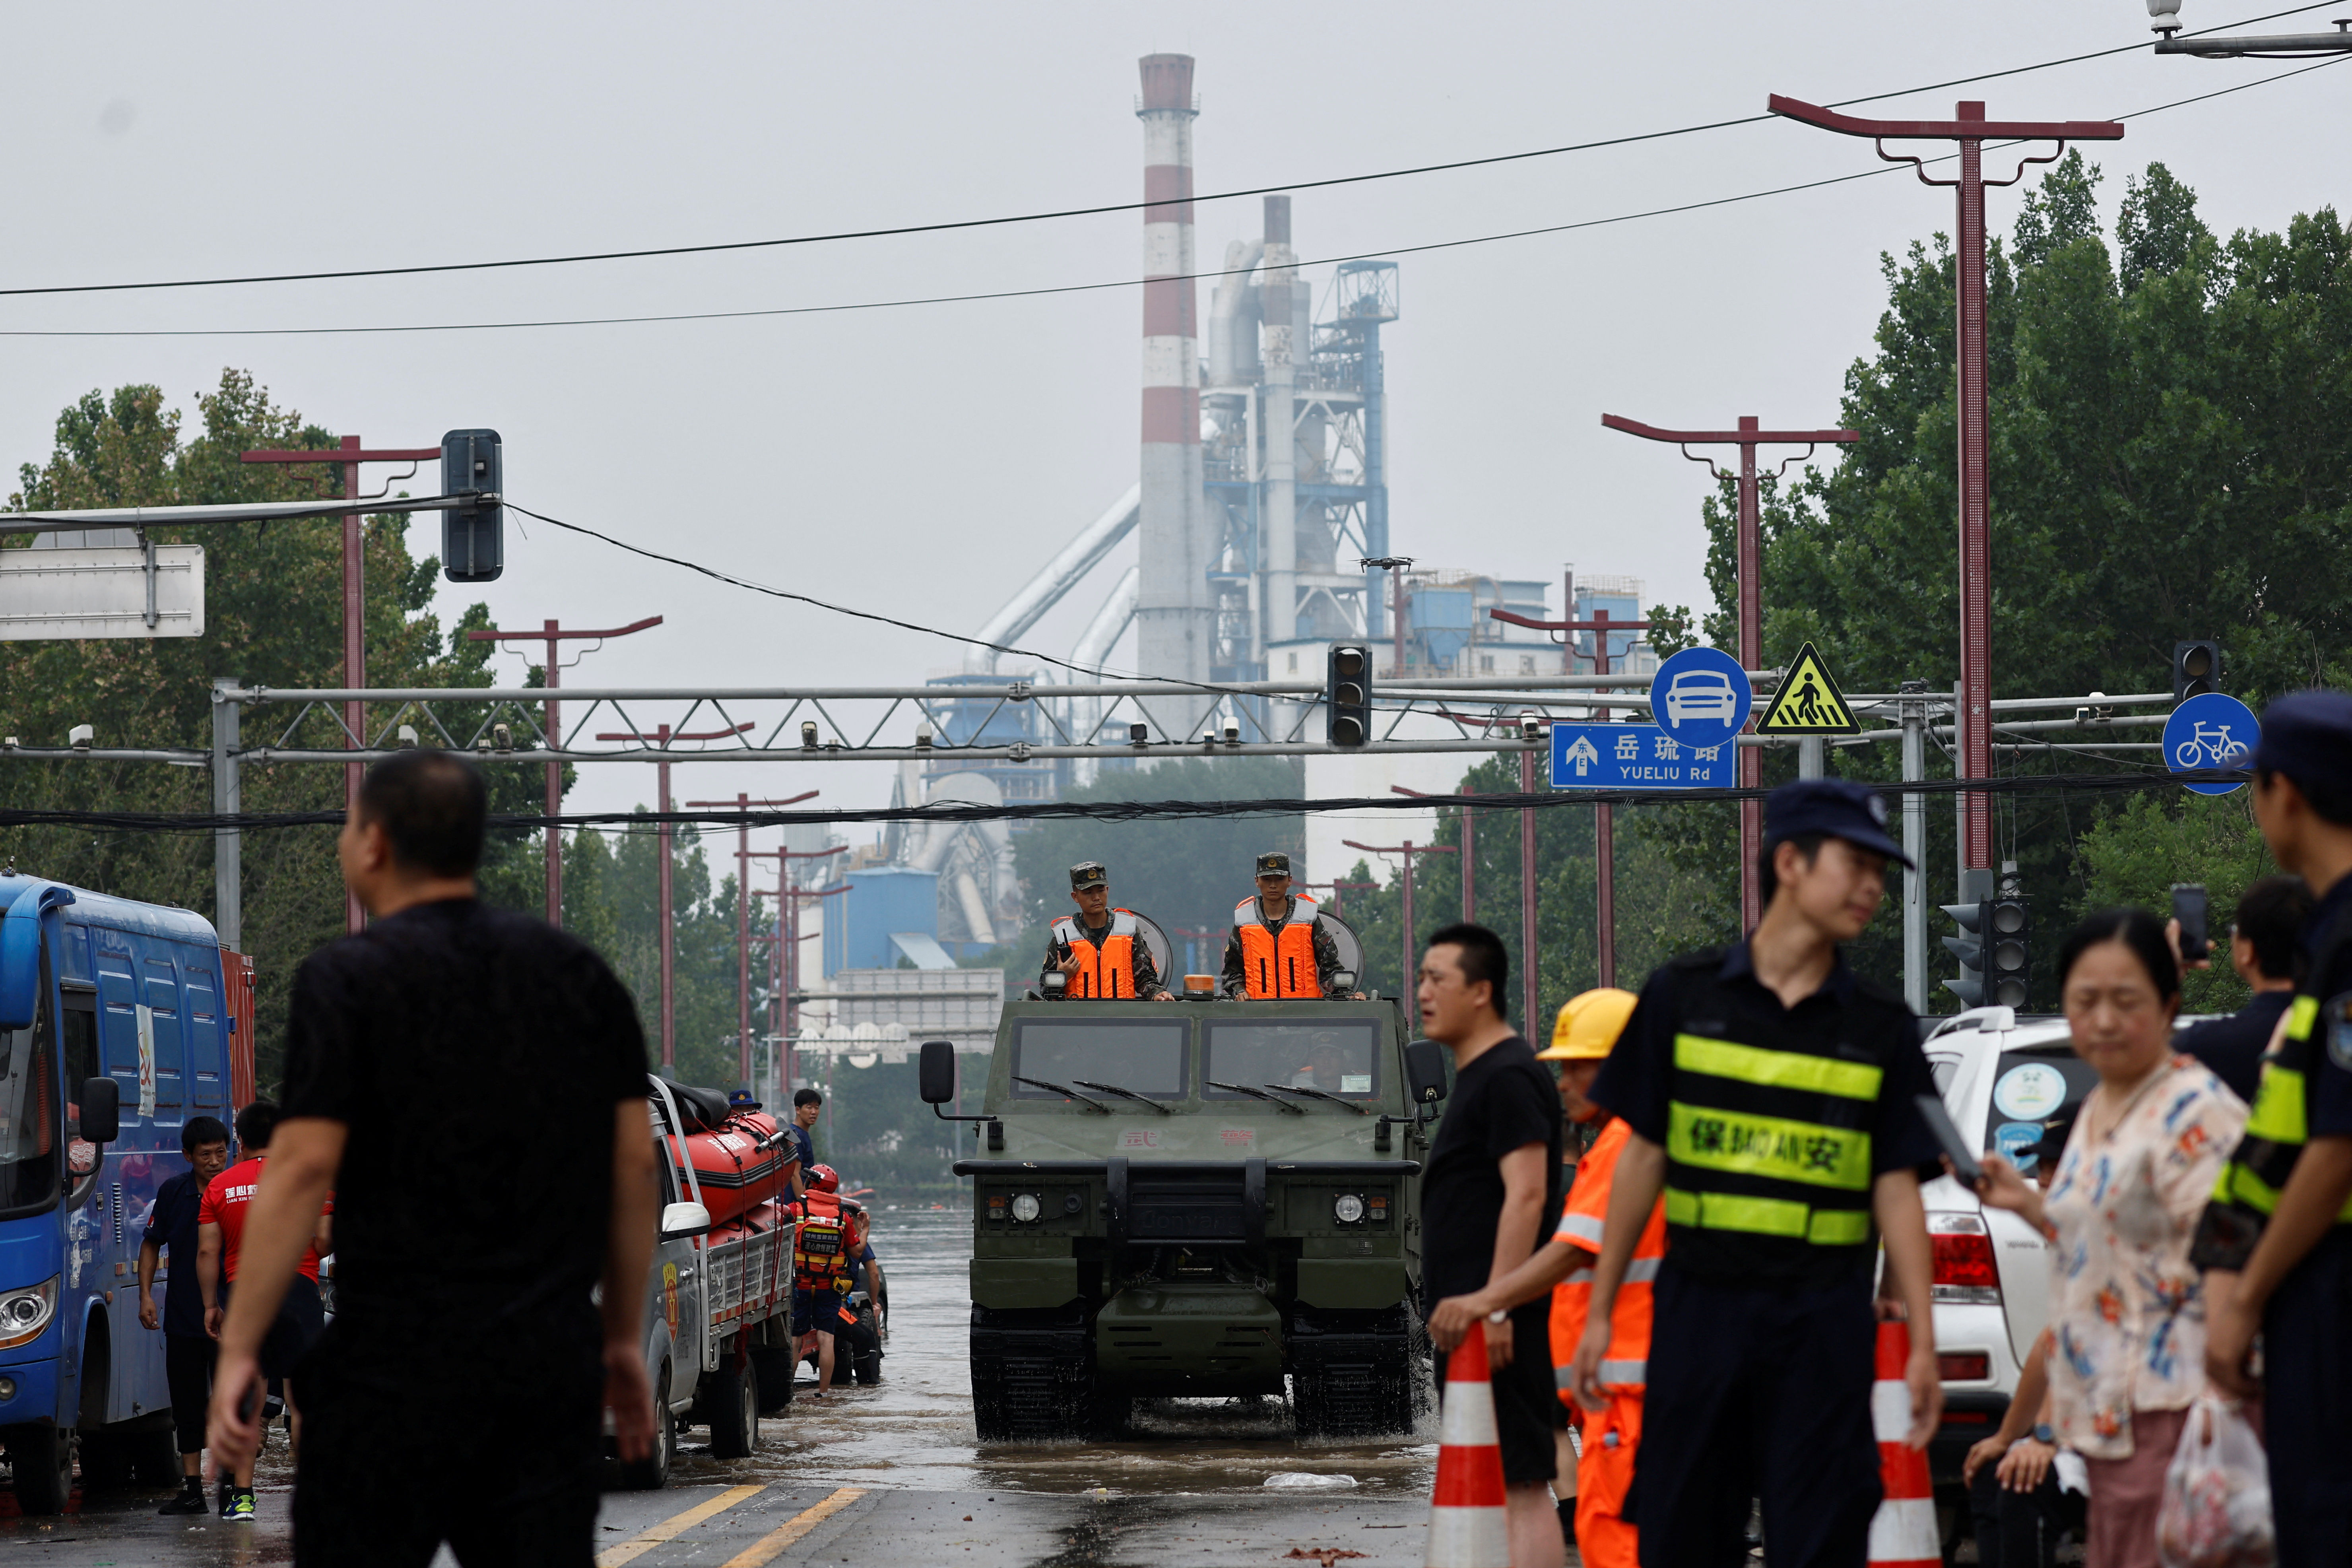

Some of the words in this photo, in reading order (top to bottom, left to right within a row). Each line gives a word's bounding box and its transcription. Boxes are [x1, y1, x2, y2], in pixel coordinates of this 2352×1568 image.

[1578, 743, 1587, 753] 东
[1580, 758, 1585, 767] E
[1620, 767, 1679, 780] YUELIU
[1690, 767, 1710, 780] Rd
